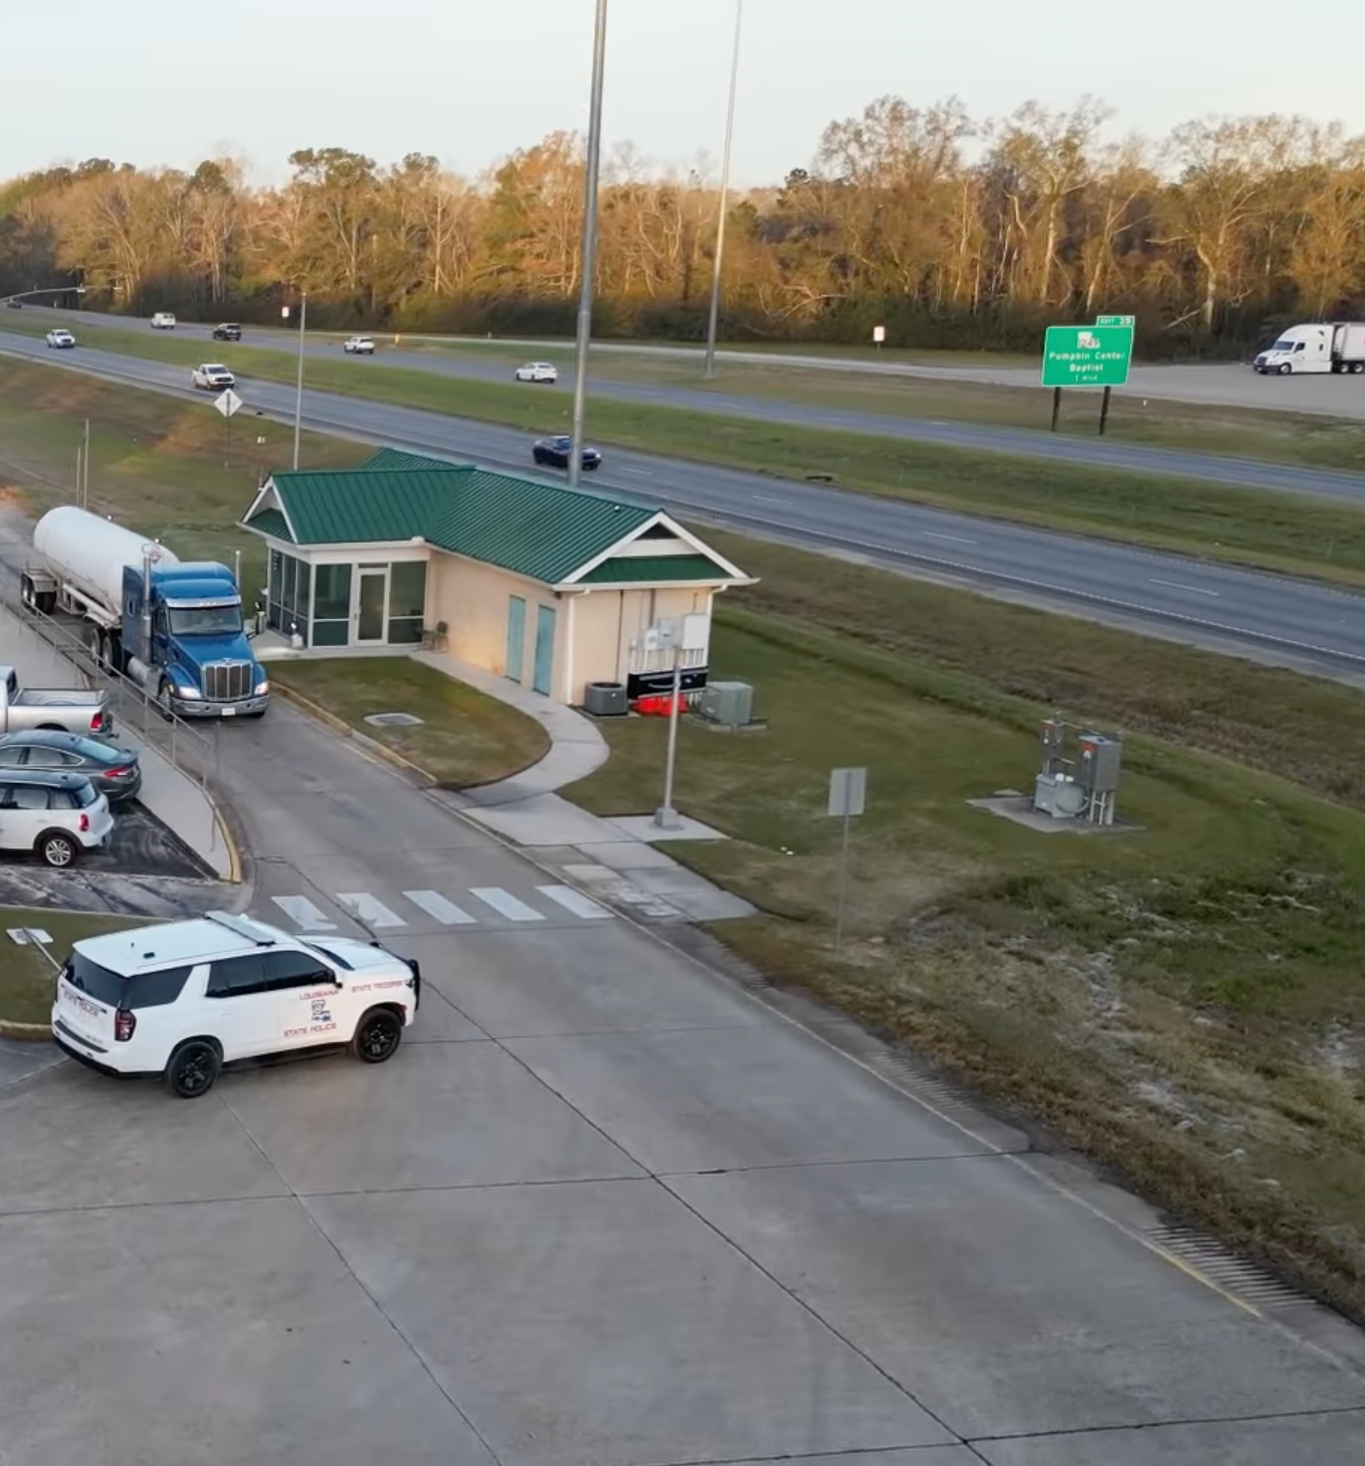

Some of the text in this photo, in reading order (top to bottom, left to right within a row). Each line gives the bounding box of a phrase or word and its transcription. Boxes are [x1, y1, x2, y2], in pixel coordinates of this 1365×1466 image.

[1049, 351, 1125, 361] Pumpkin Center
[1069, 363, 1104, 373] Baptist
[352, 984, 372, 992] STATE
[283, 1022, 337, 1036] STATE POLICE
